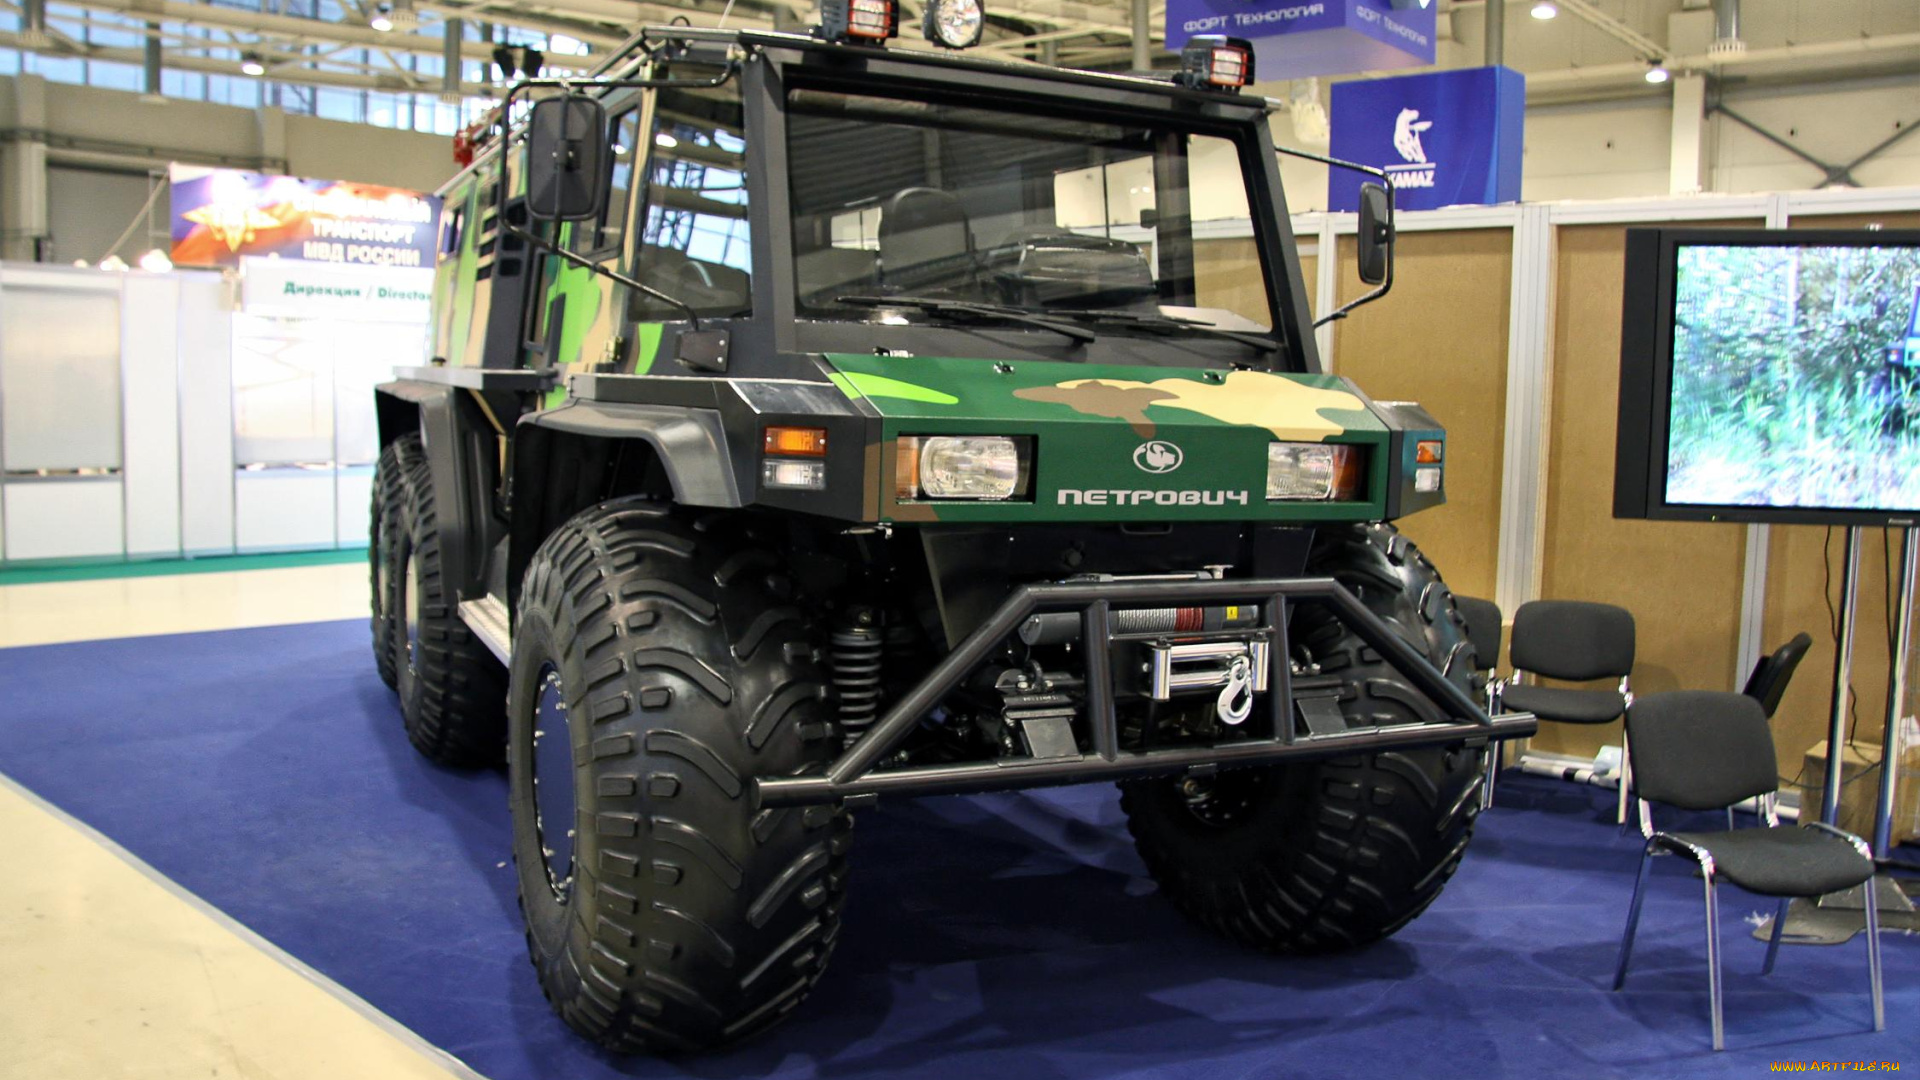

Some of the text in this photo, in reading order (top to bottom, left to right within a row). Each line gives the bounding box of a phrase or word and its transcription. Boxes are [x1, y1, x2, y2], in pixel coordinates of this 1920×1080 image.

[1183, 14, 1228, 33] ФОРТ
[310, 217, 416, 245] ТРАНСПОРТ
[303, 241, 421, 267] МВД РОССИИ
[1057, 489, 1249, 506] ПЕТРОВИЧ
